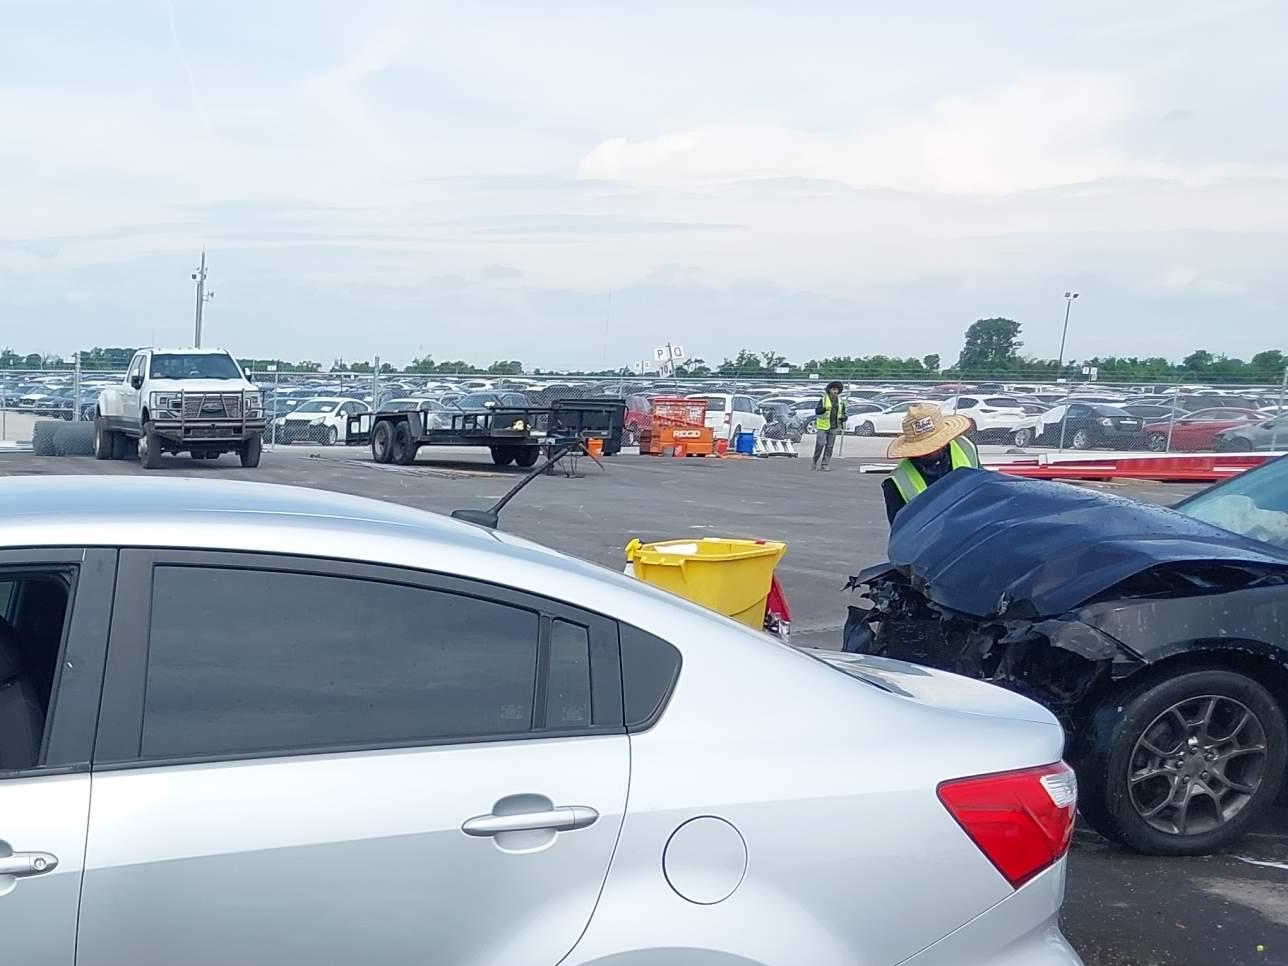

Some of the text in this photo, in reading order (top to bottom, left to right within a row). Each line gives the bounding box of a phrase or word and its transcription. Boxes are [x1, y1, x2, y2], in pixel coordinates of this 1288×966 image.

[657, 346, 683, 359] P Q
[673, 430, 701, 439] RIDGID
